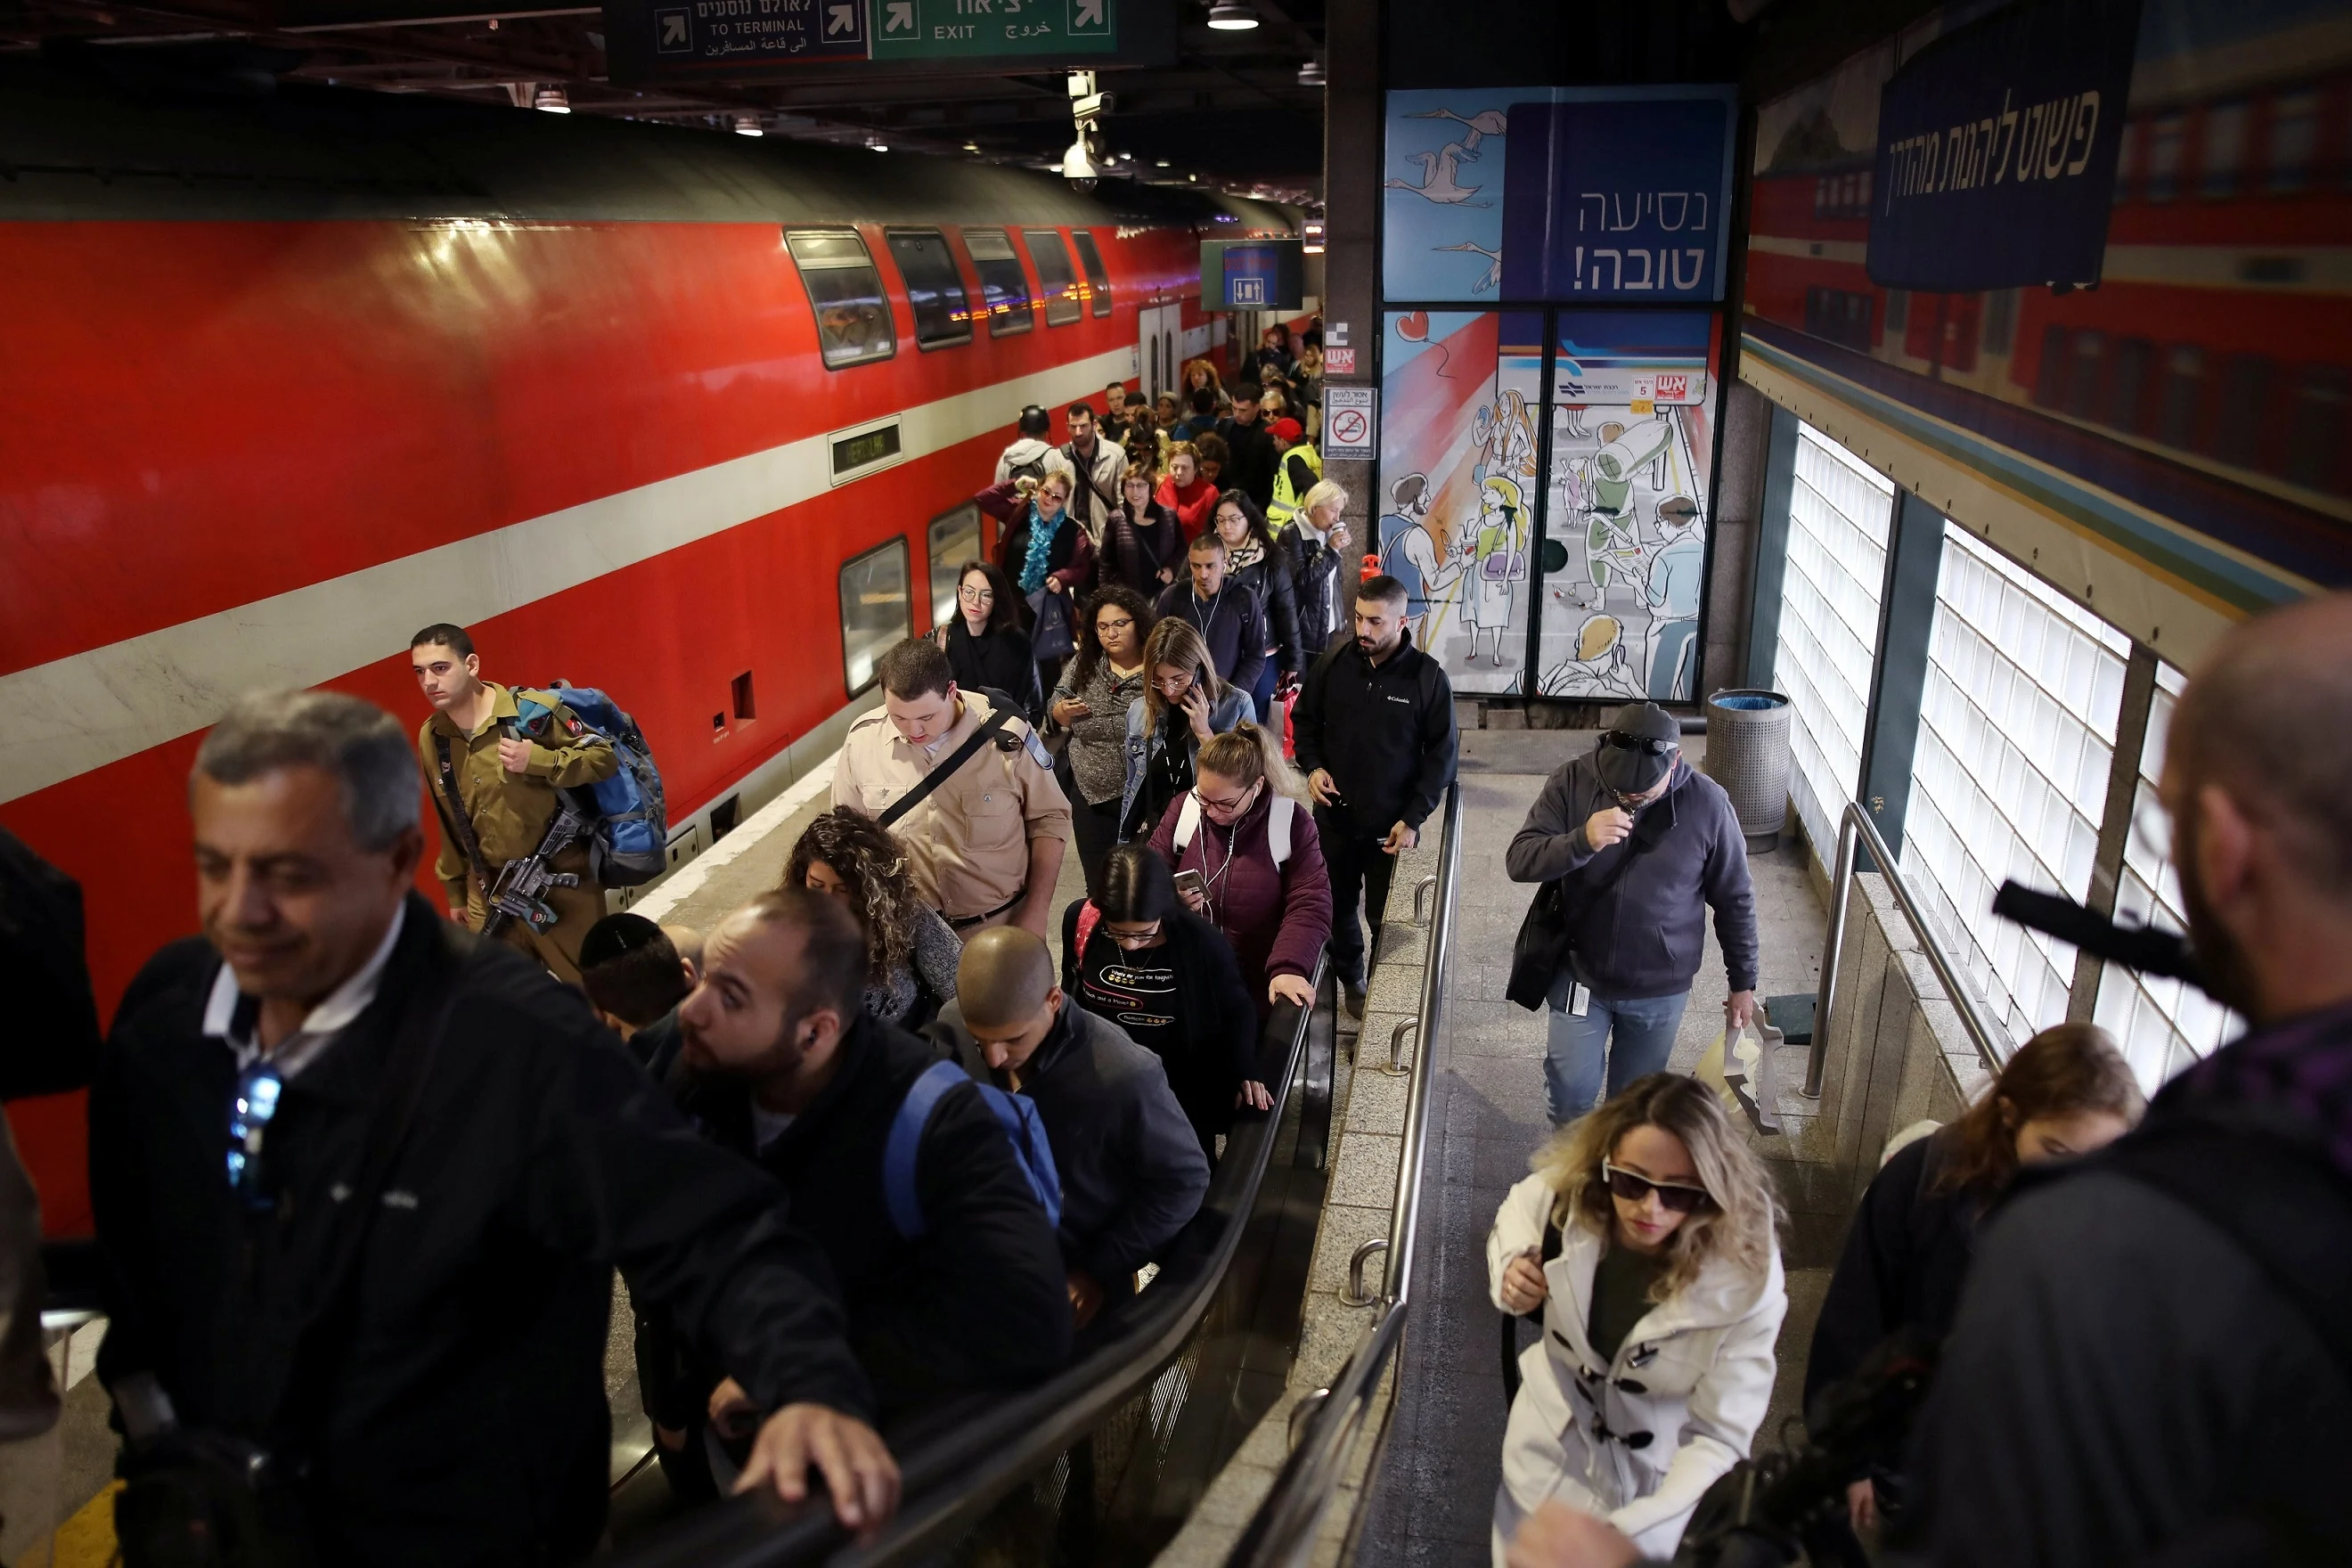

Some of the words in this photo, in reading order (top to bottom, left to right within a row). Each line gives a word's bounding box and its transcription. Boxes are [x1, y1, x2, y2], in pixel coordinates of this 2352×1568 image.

[697, 0, 752, 18] נוסעים
[710, 24, 729, 36] TO
[735, 20, 804, 34] TERMINAL
[934, 25, 976, 39] EXIT
[1005, 20, 1051, 39] خروج
[705, 40, 755, 56] المسافرين
[761, 37, 786, 50] قاعة
[1939, 87, 2019, 192] ליהנות
[2017, 90, 2100, 183] פשוט
[1885, 131, 1940, 217] מהדרך
[1580, 192, 1708, 232] נסיעה
[1573, 246, 1705, 290] טובה!
[1327, 350, 1352, 363] אש
[1640, 387, 1646, 396] 5
[1658, 377, 1686, 391] אש
[1333, 390, 1350, 400] לעשן
